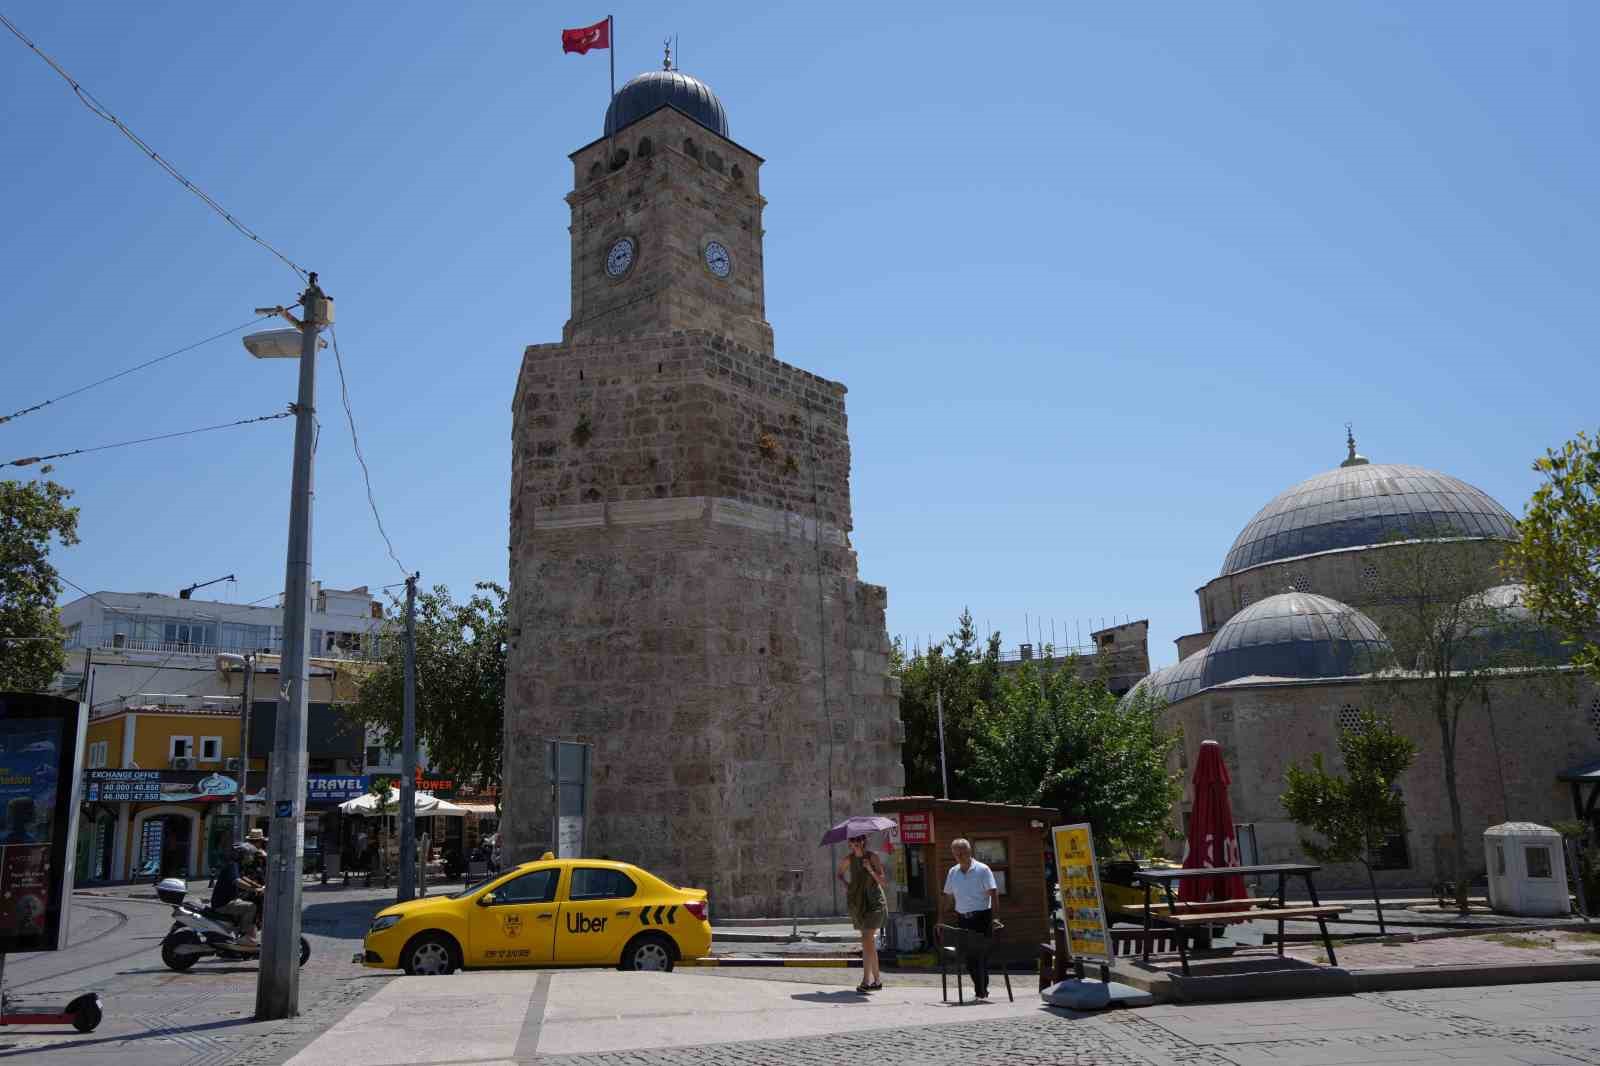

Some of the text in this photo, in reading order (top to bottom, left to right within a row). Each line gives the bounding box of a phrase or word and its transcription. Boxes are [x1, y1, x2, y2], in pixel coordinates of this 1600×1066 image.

[91, 771, 160, 779] EXCHANGE OFFICE
[308, 779, 363, 790] TRAVEL
[416, 780, 453, 790] TOWER
[566, 911, 608, 933] Uber
